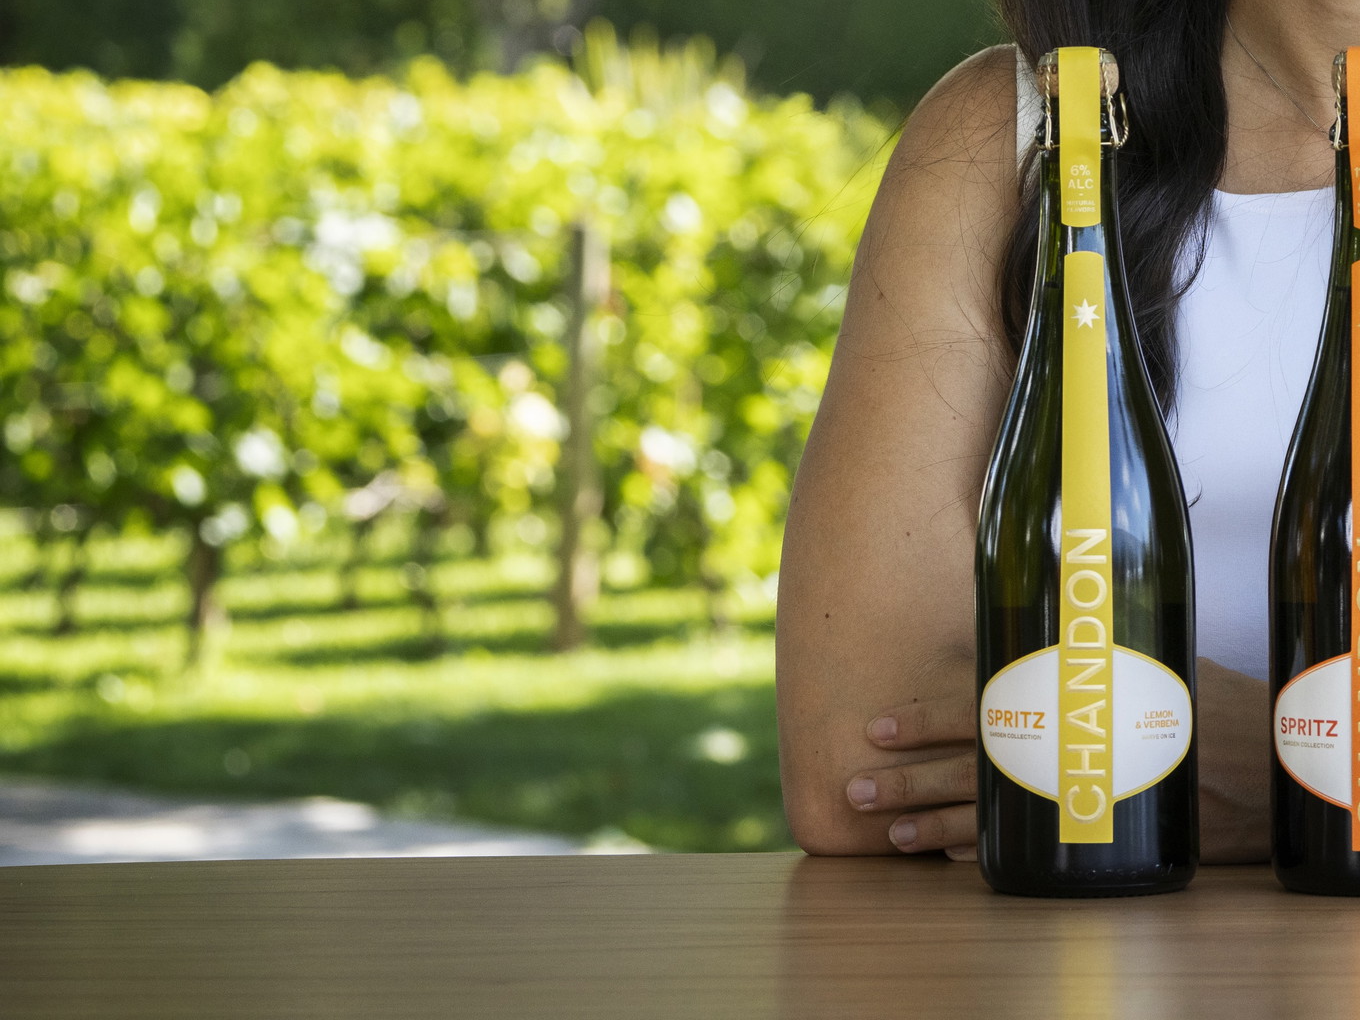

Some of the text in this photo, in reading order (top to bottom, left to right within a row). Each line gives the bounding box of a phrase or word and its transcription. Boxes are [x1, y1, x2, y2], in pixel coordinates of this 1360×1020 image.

[1070, 164, 1091, 176] 6%
[1068, 178, 1094, 190] ALC
[1065, 528, 1107, 824] CHANDON
[987, 708, 1046, 729] SPRITZ
[1144, 709, 1174, 720] LEMON
[1135, 718, 1180, 730] & VERBENA
[1280, 716, 1338, 737] SPRITZ
[1007, 732, 1042, 740] COLLECTION
[1300, 741, 1335, 749] COLLECTION
